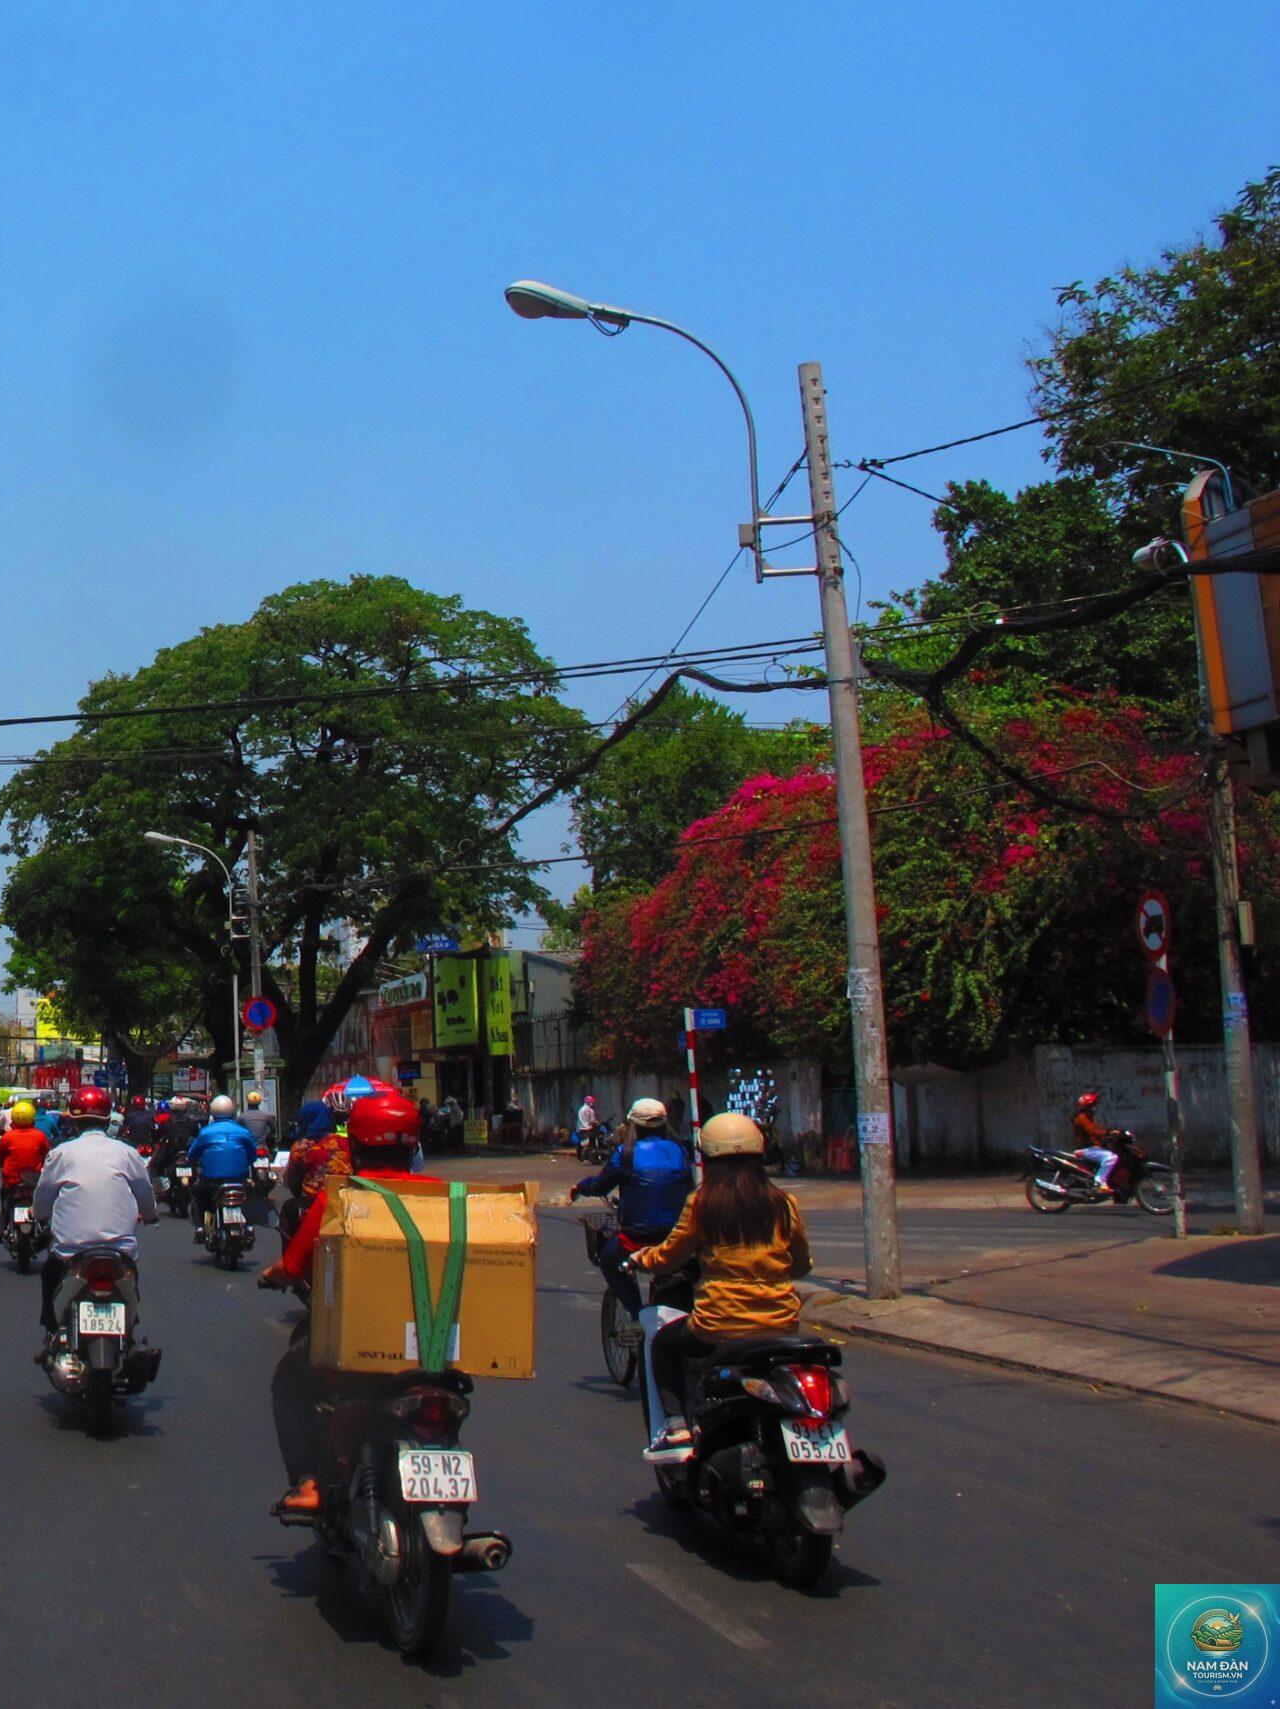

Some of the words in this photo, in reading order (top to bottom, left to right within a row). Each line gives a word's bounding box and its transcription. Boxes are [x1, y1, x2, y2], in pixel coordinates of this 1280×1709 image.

[83, 1320, 121, 1331] 185.24
[358, 1351, 403, 1360] TP-LINK
[790, 1441, 847, 1459] 055.20
[407, 1477, 470, 1498] 204.37
